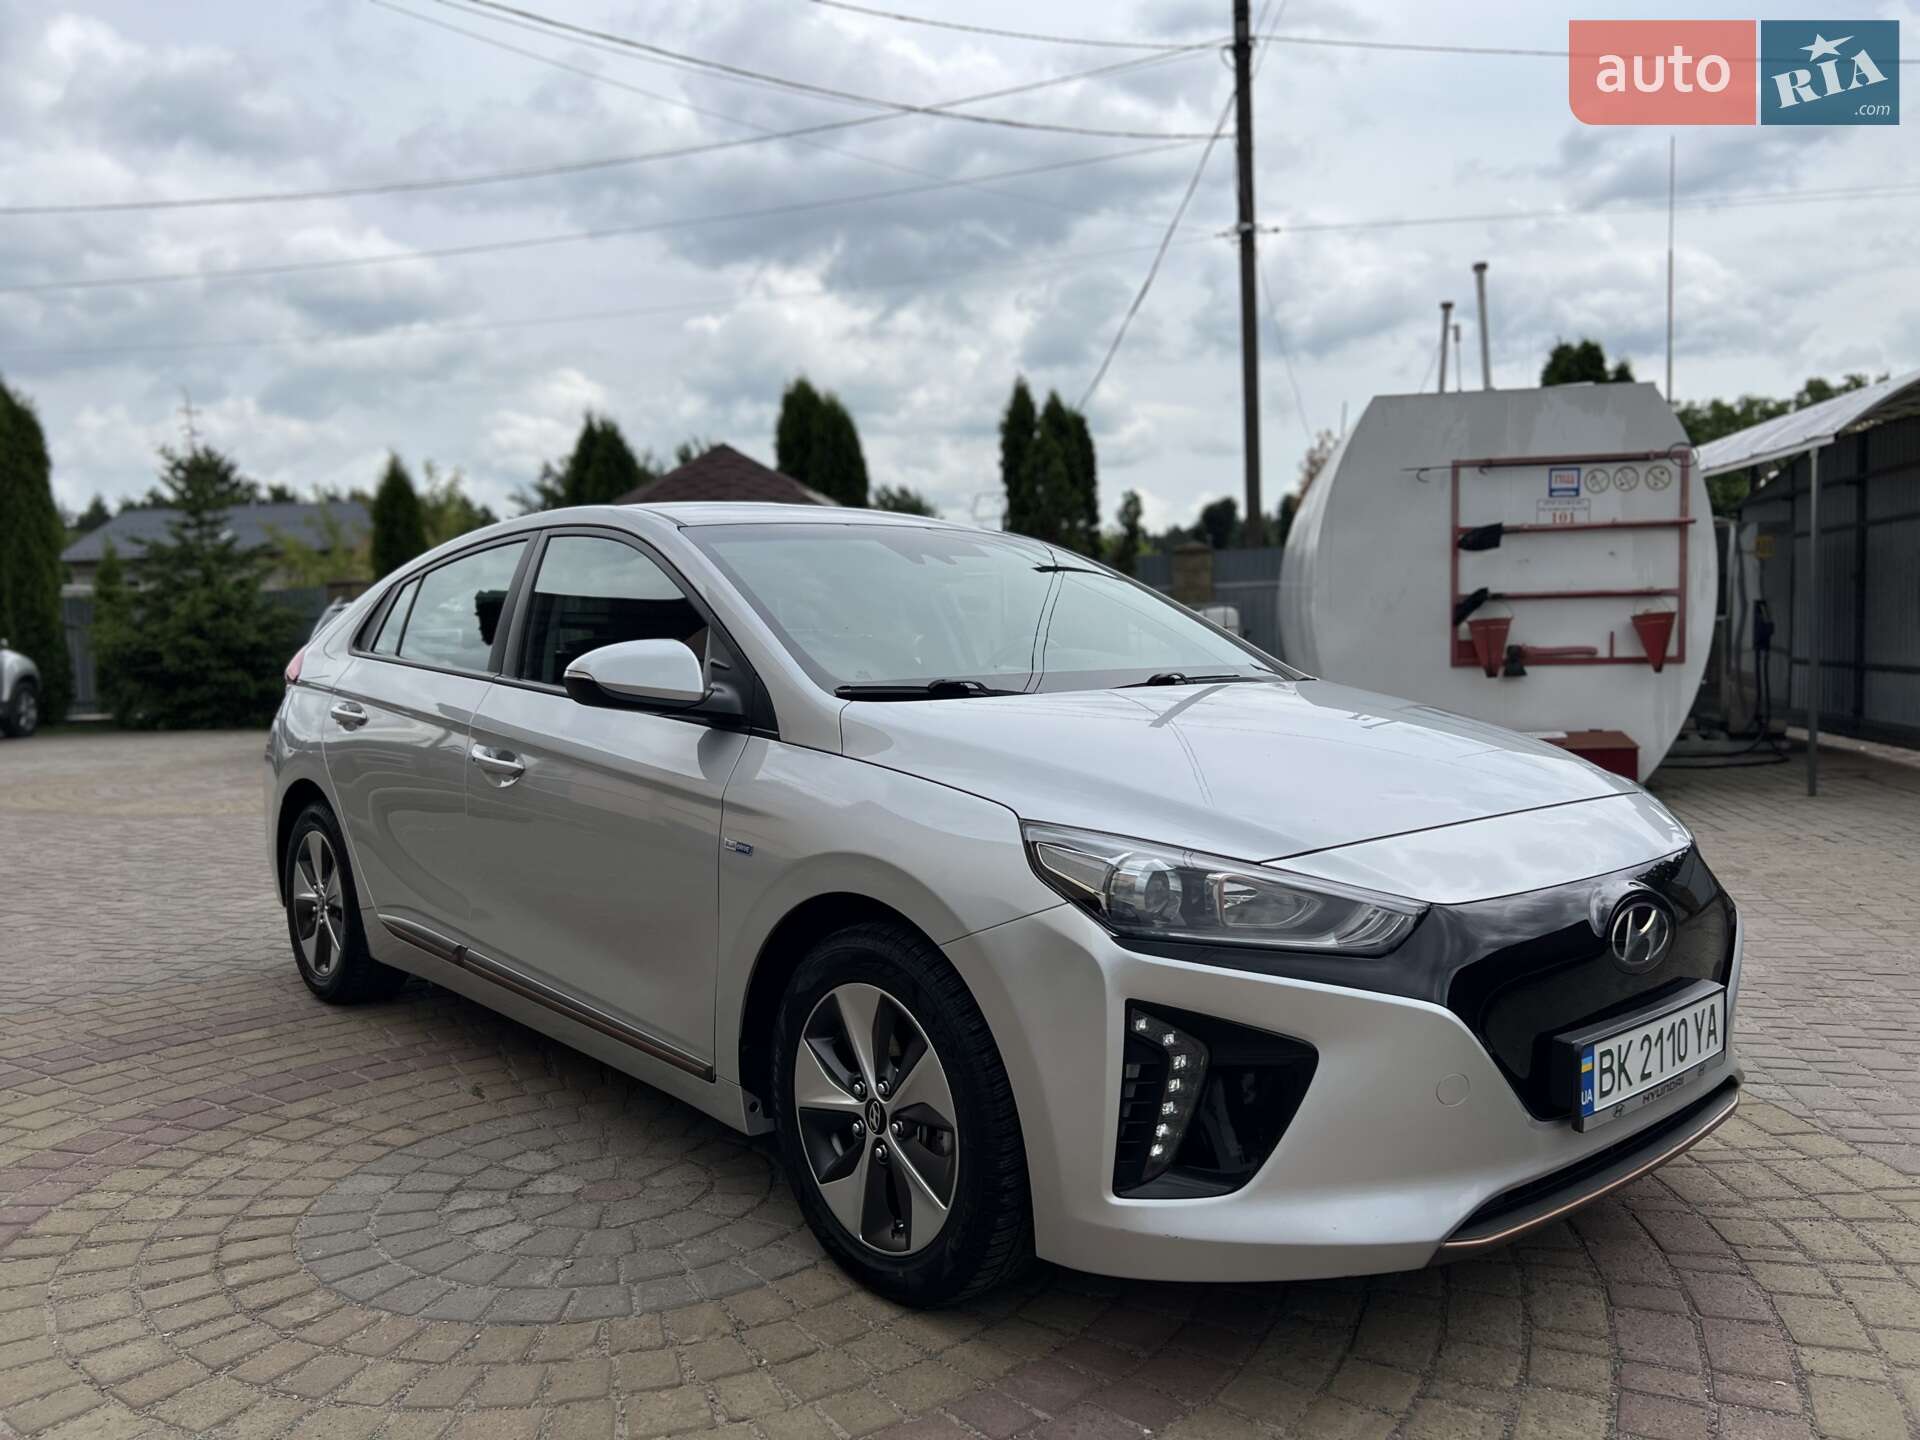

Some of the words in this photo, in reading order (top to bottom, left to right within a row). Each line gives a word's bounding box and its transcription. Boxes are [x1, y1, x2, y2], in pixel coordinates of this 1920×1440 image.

[1599, 1039, 1633, 1099] BK
[1639, 1017, 1688, 1082] 2110
[1693, 1003, 1718, 1054] YA
[1581, 1088, 1593, 1105] UA
